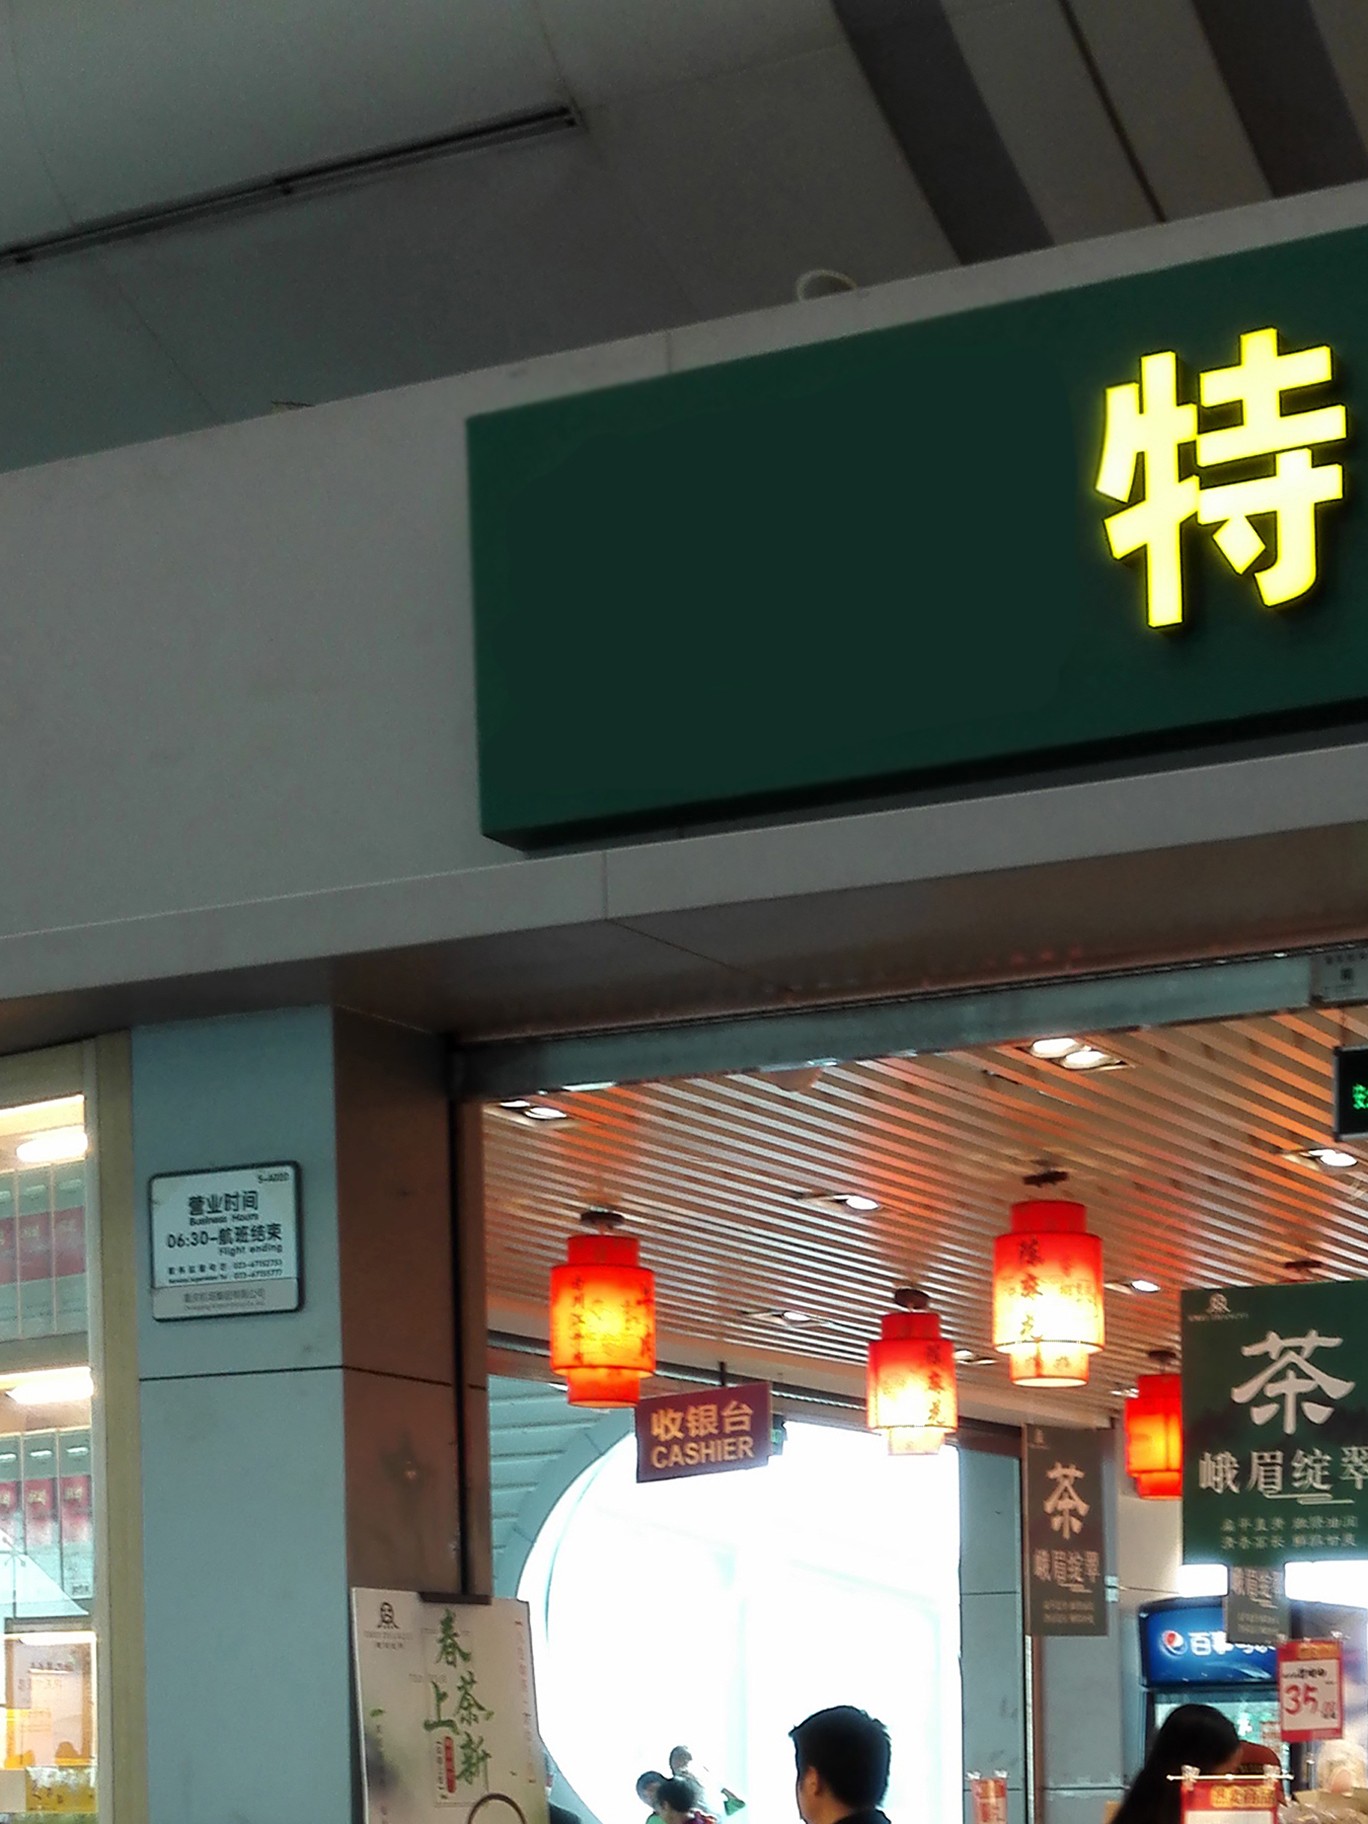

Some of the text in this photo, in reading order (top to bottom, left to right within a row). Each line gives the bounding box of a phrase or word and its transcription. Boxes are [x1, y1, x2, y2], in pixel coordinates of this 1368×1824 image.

[188, 1190, 259, 1216] 营业时间
[189, 1213, 259, 1226] Business Hours
[167, 1223, 282, 1248] 06:30-航班结束
[219, 1243, 283, 1257] Flight ending
[1231, 1329, 1356, 1435] 茶
[651, 1400, 753, 1443] 收银台
[652, 1436, 755, 1469] CASHIER
[1043, 1462, 1090, 1541] 茶
